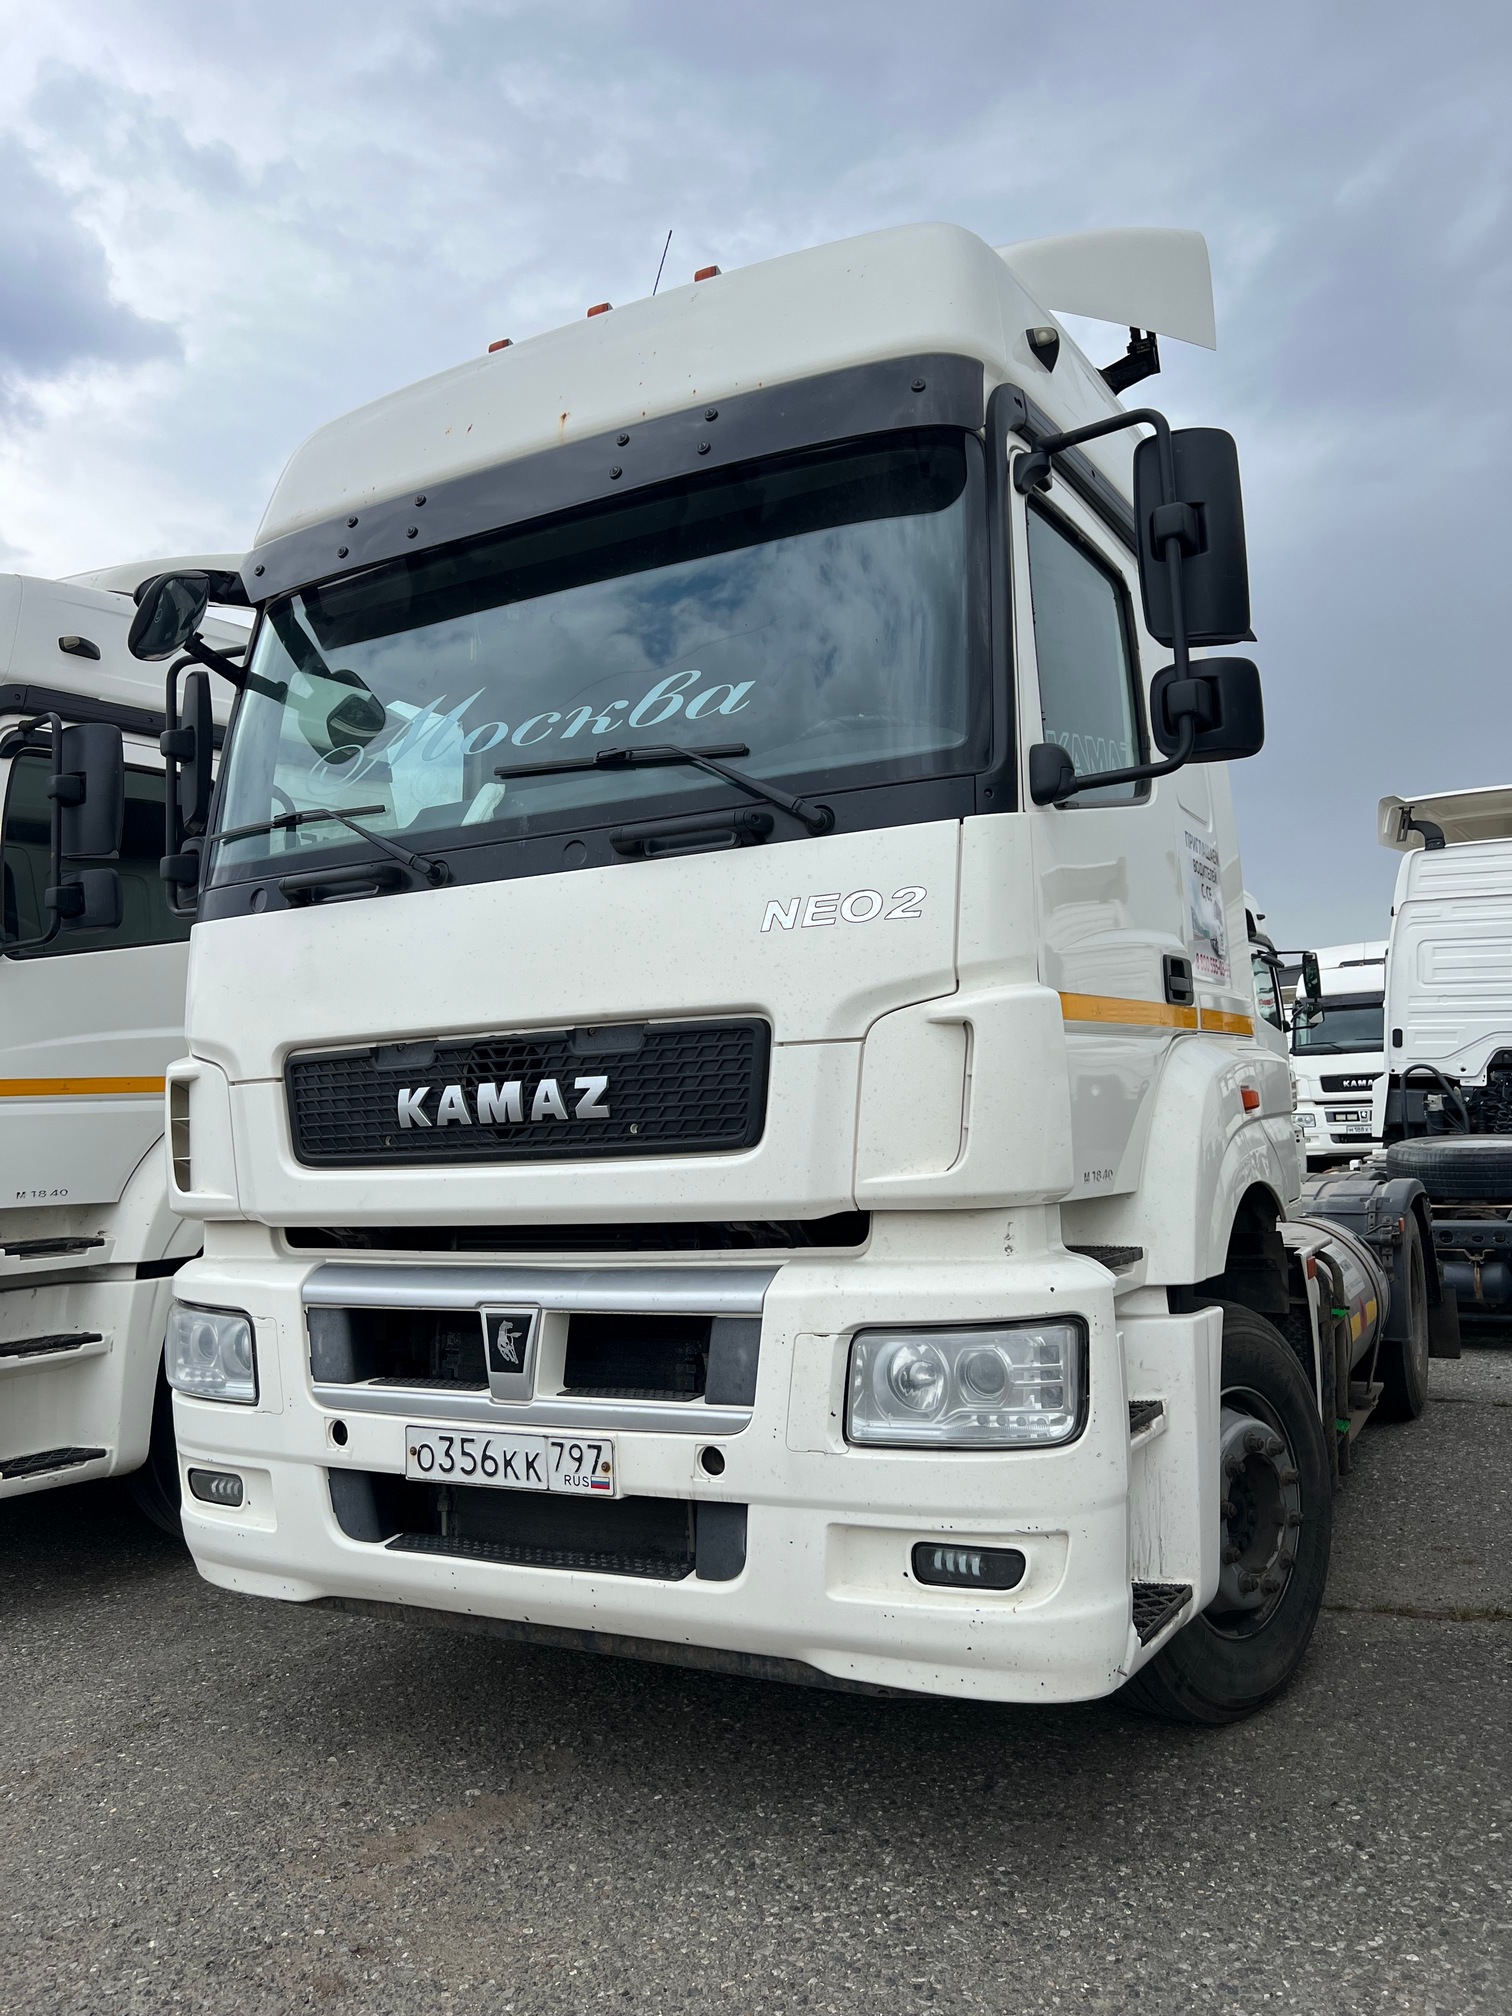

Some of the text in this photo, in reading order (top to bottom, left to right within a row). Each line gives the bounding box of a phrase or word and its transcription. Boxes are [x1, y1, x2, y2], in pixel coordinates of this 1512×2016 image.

[307, 670, 757, 795] Москва
[397, 1075, 611, 1128] KAMAZ
[551, 1441, 603, 1475] 797
[564, 1474, 590, 1488] RUS
